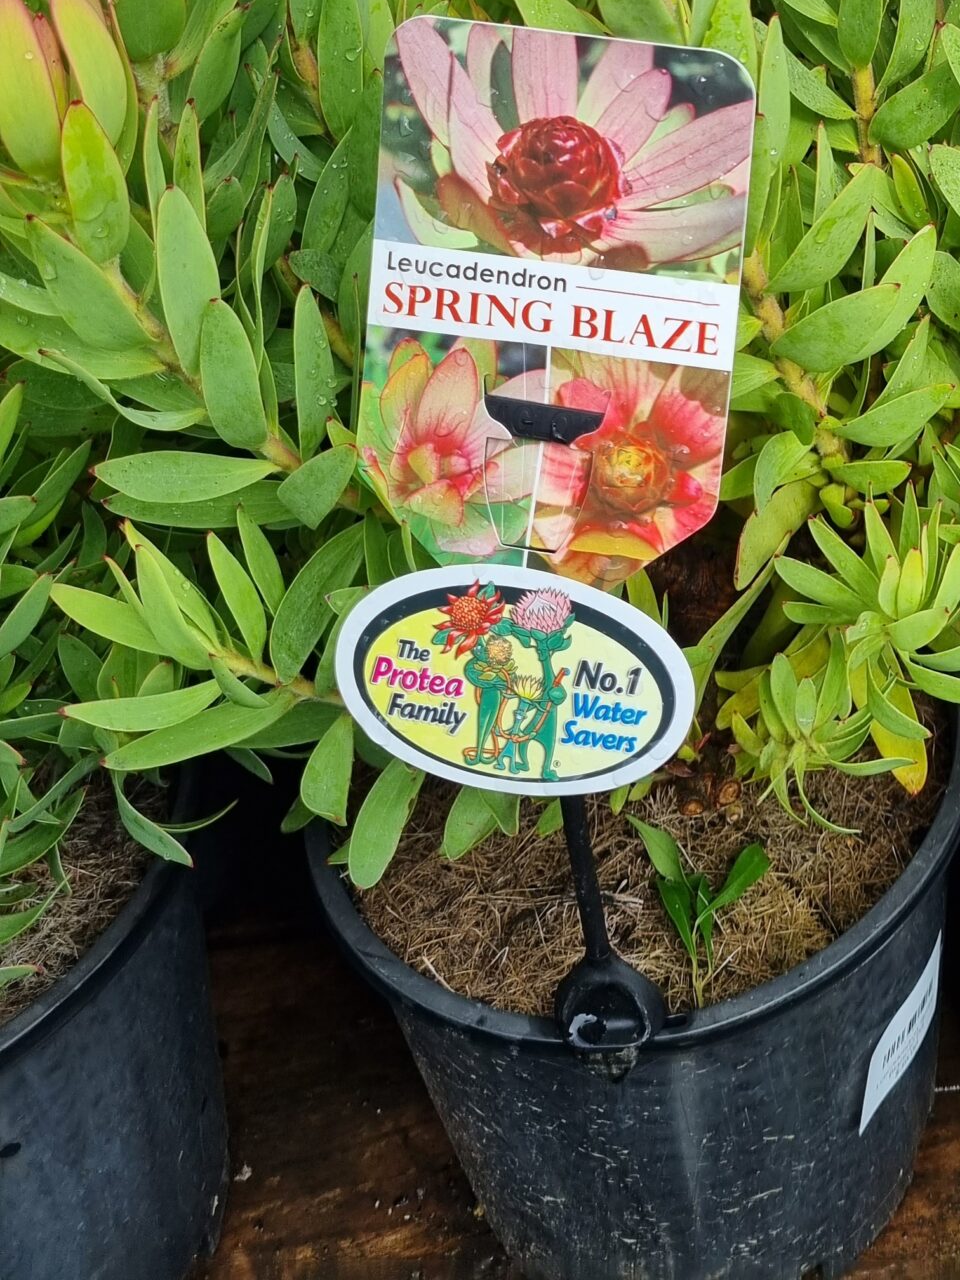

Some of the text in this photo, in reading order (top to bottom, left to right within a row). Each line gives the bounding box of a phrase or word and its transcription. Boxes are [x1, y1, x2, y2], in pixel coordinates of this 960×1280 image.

[387, 251, 567, 292] Leucadendron
[382, 281, 719, 356] SPRING BLAZE
[398, 638, 431, 661] The
[371, 656, 464, 697] Protea
[574, 659, 642, 695] No.1
[388, 692, 468, 734] Family
[573, 692, 648, 726] Water
[560, 720, 637, 753] Savers
